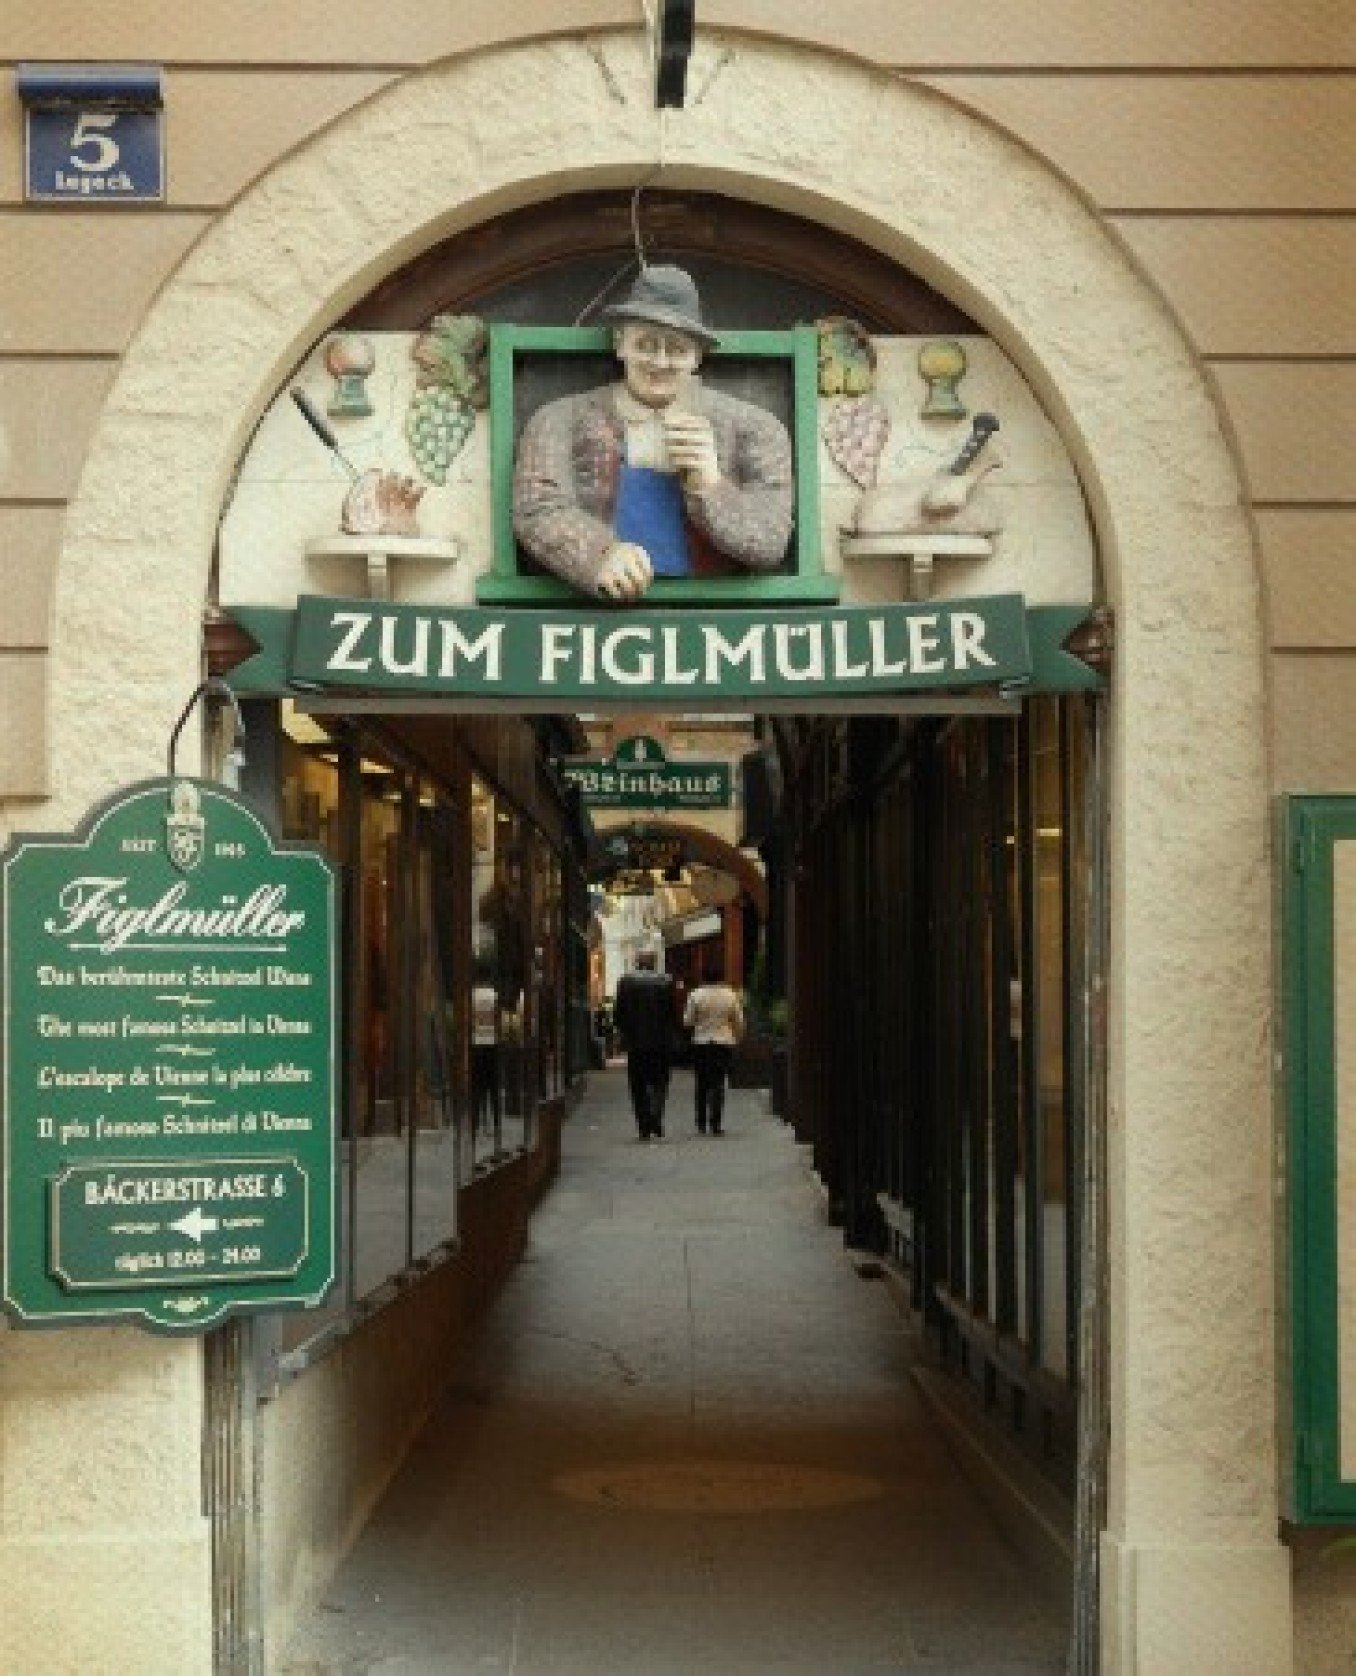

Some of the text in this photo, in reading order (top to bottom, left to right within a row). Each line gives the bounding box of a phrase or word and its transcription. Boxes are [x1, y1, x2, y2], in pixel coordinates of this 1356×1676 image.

[69, 114, 120, 172] 5
[326, 611, 997, 685] ZUM FIGLMÜLLER
[44, 876, 306, 956] Figlmüller
[84, 1174, 266, 1205] BÄCKERSTRASSE
